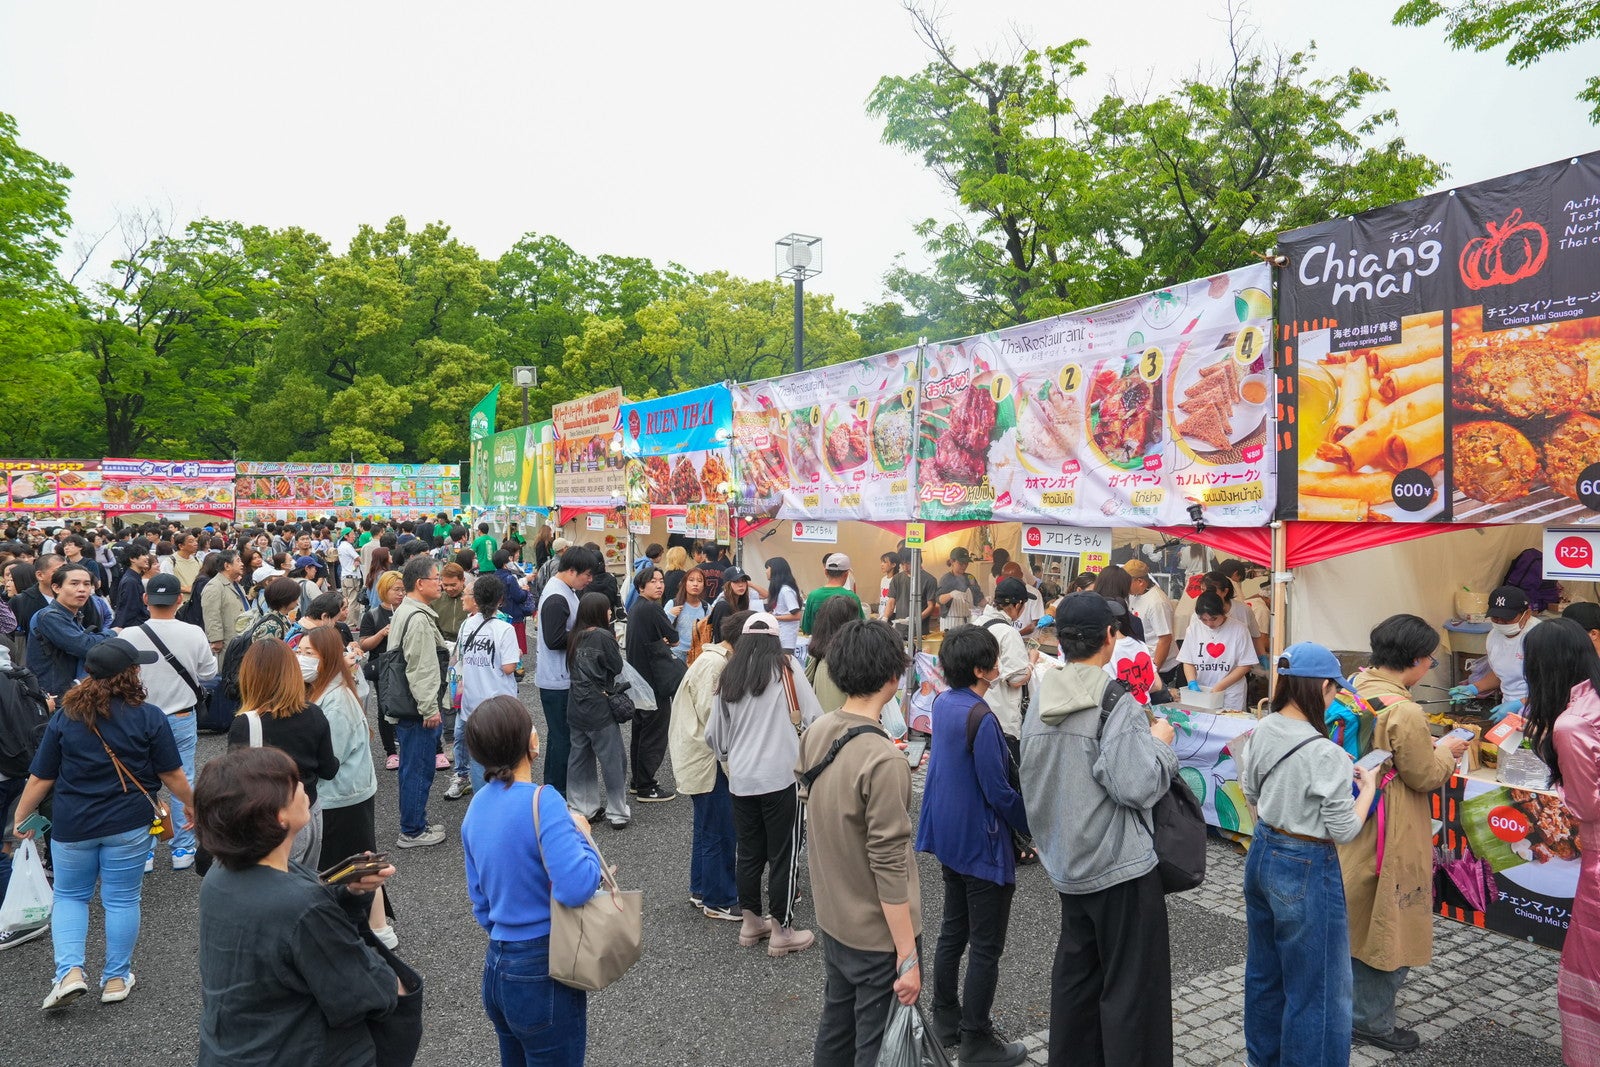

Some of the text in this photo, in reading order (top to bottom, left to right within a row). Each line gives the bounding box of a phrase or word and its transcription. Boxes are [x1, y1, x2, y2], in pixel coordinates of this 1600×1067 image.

[1563, 195, 1600, 212] Auth
[1389, 221, 1442, 243] チェンマイ
[1559, 236, 1600, 250] Thai c
[1299, 240, 1442, 286] Chiang
[1332, 271, 1412, 306] mai
[1503, 308, 1583, 326] Chiang Mai Sausage
[1333, 320, 1399, 340] 海老の揚げ春巻
[1021, 326, 1086, 353] Restaurant
[1241, 331, 1254, 359] 4
[1338, 334, 1393, 349] shrimp spring rolls
[1147, 351, 1157, 378] 3
[996, 377, 1003, 399] 1
[1065, 367, 1075, 391] 2
[813, 408, 820, 424] 6
[860, 400, 866, 418] 7
[645, 408, 679, 436] RUEN
[781, 412, 788, 428] 5
[140, 461, 200, 478] タイ村
[1176, 469, 1261, 487] カノムパンナークン
[1025, 476, 1078, 489] カオマンガイ
[1108, 474, 1162, 488] ガイヤーン
[1394, 483, 1431, 497] 600¥
[920, 484, 967, 503] ムーピン
[1135, 490, 1162, 503] ไก่ย่าง
[805, 525, 834, 535] アロイちゃん
[1028, 531, 1102, 547] R26 アロイちゃん
[1560, 546, 1588, 559] R25
[706, 579, 718, 598] 7
[1198, 642, 1204, 658] I
[1120, 660, 1150, 681] アロイ
[1490, 815, 1525, 834] 600¥
[1514, 907, 1569, 930] Chiang Mai S
